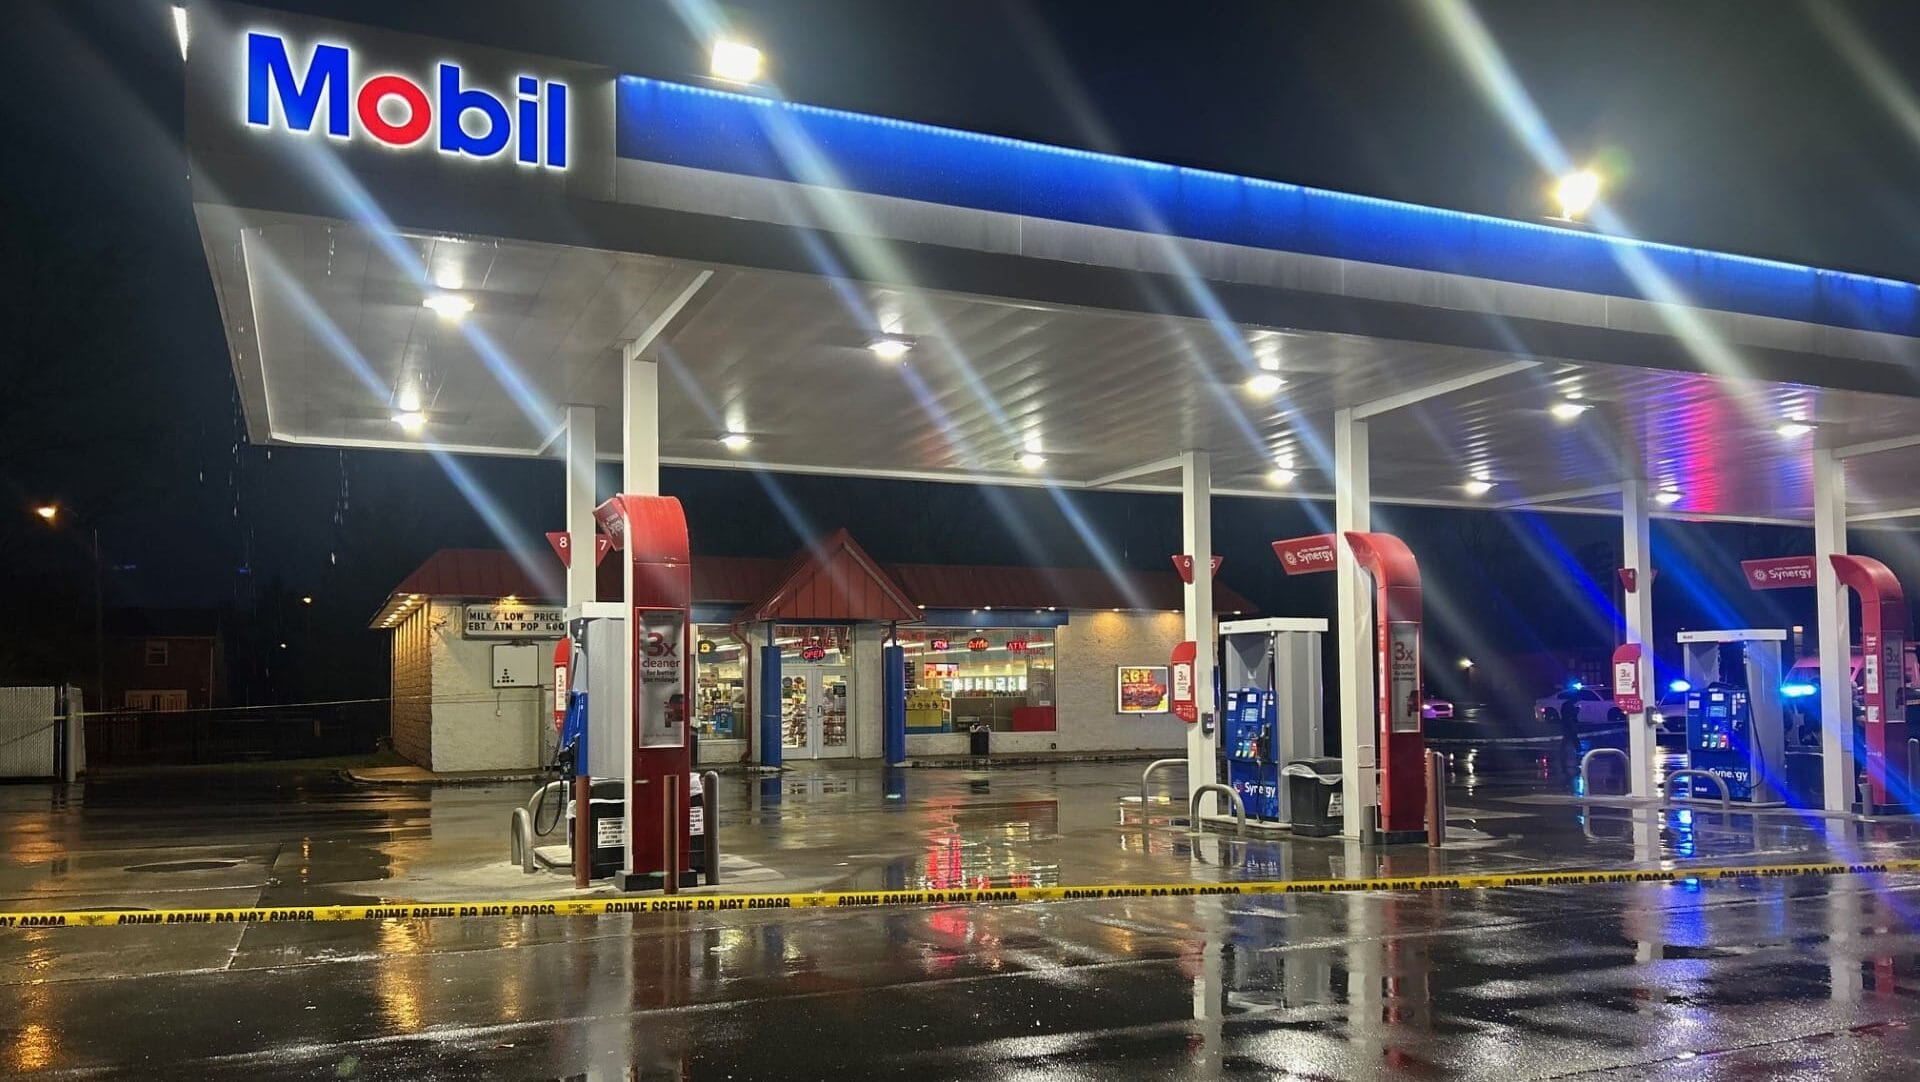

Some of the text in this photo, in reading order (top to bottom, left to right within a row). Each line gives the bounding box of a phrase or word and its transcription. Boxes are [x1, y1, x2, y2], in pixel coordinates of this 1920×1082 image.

[246, 30, 568, 169] Mobil
[559, 536, 568, 548] 8
[599, 539, 607, 551] 7
[1296, 550, 1334, 564] Synergy
[1184, 558, 1191, 568] 6
[1768, 568, 1812, 581] Synergy
[504, 612, 524, 621] LOW
[533, 612, 560, 621] PRICE
[468, 622, 486, 631] EBT
[493, 622, 513, 631] ATM
[520, 622, 539, 631] POP
[647, 631, 678, 657] 3x
[968, 639, 989, 650] Coffee
[1007, 642, 1026, 650] ATM
[803, 650, 824, 660] OPEN
[1394, 641, 1414, 661] 3x
[642, 659, 681, 668] cleaner
